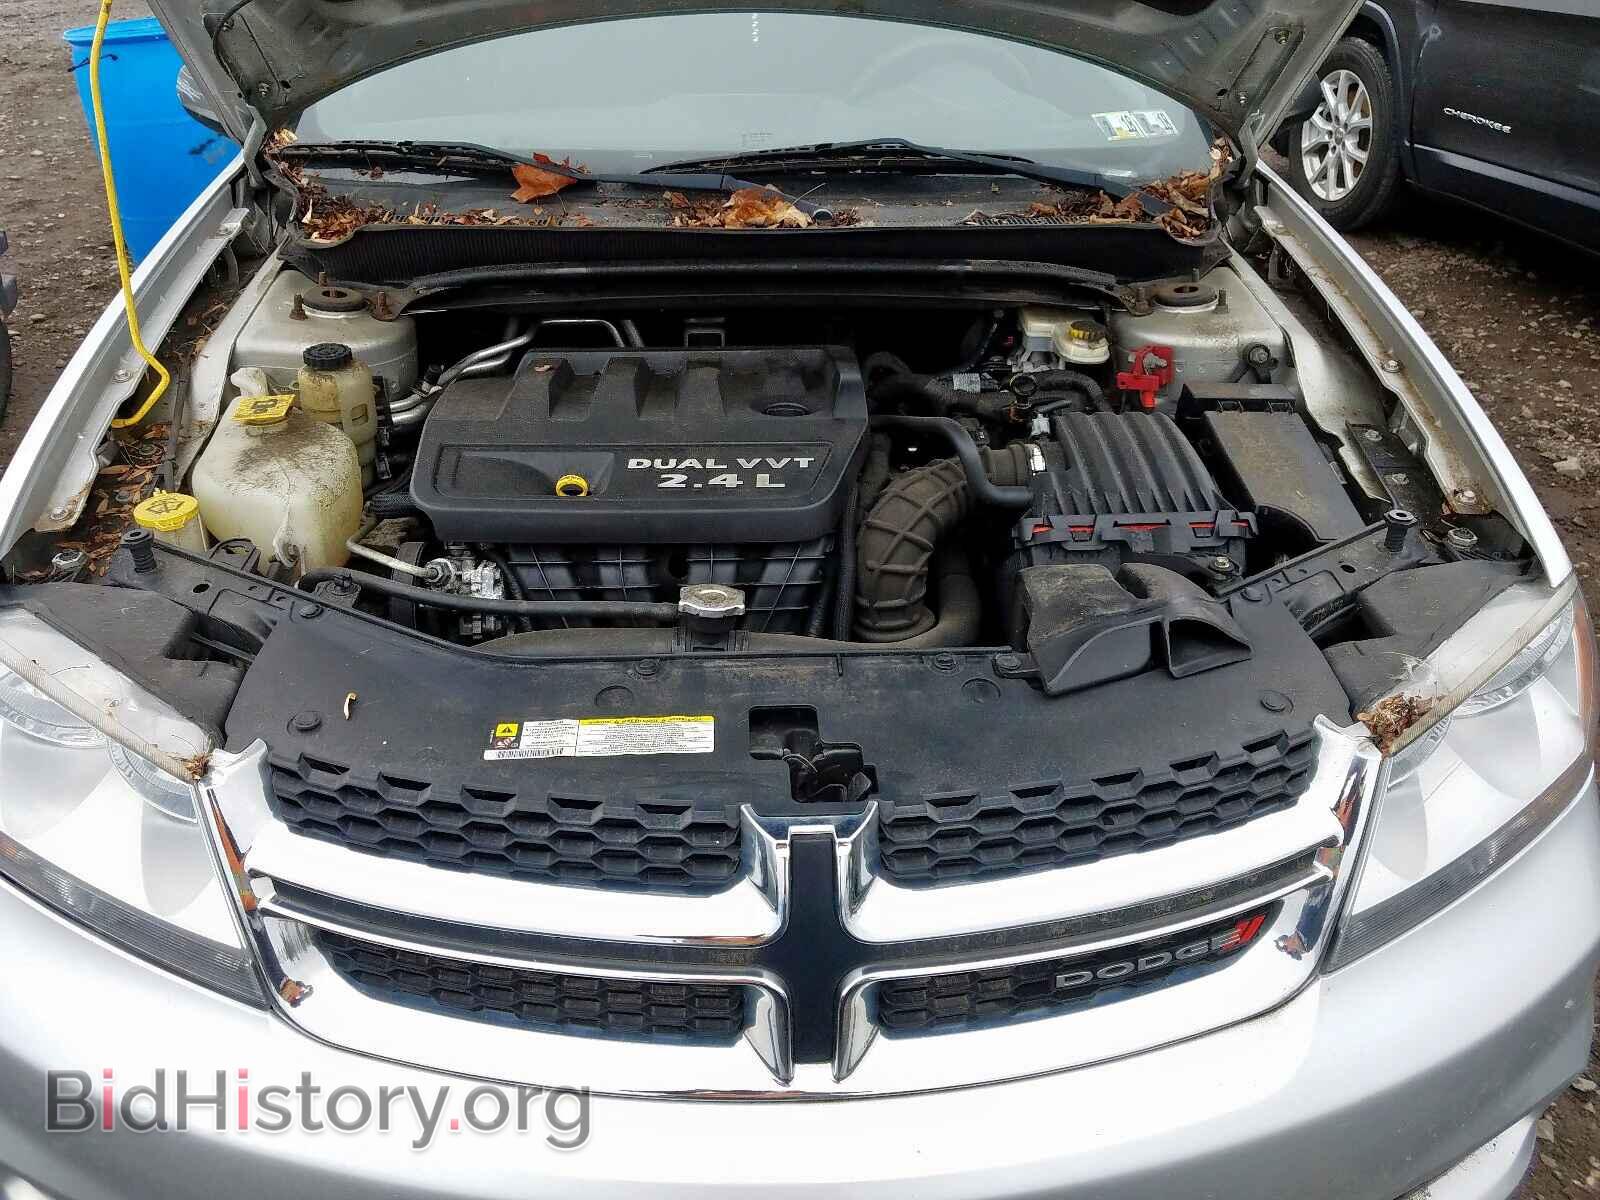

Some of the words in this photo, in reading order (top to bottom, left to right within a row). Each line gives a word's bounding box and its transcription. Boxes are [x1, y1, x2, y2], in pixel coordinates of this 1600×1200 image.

[1443, 107, 1512, 134] CHEROKEE
[627, 458, 728, 469] DUAL
[736, 457, 815, 469] VVT
[1055, 928, 1242, 989] DODGE
